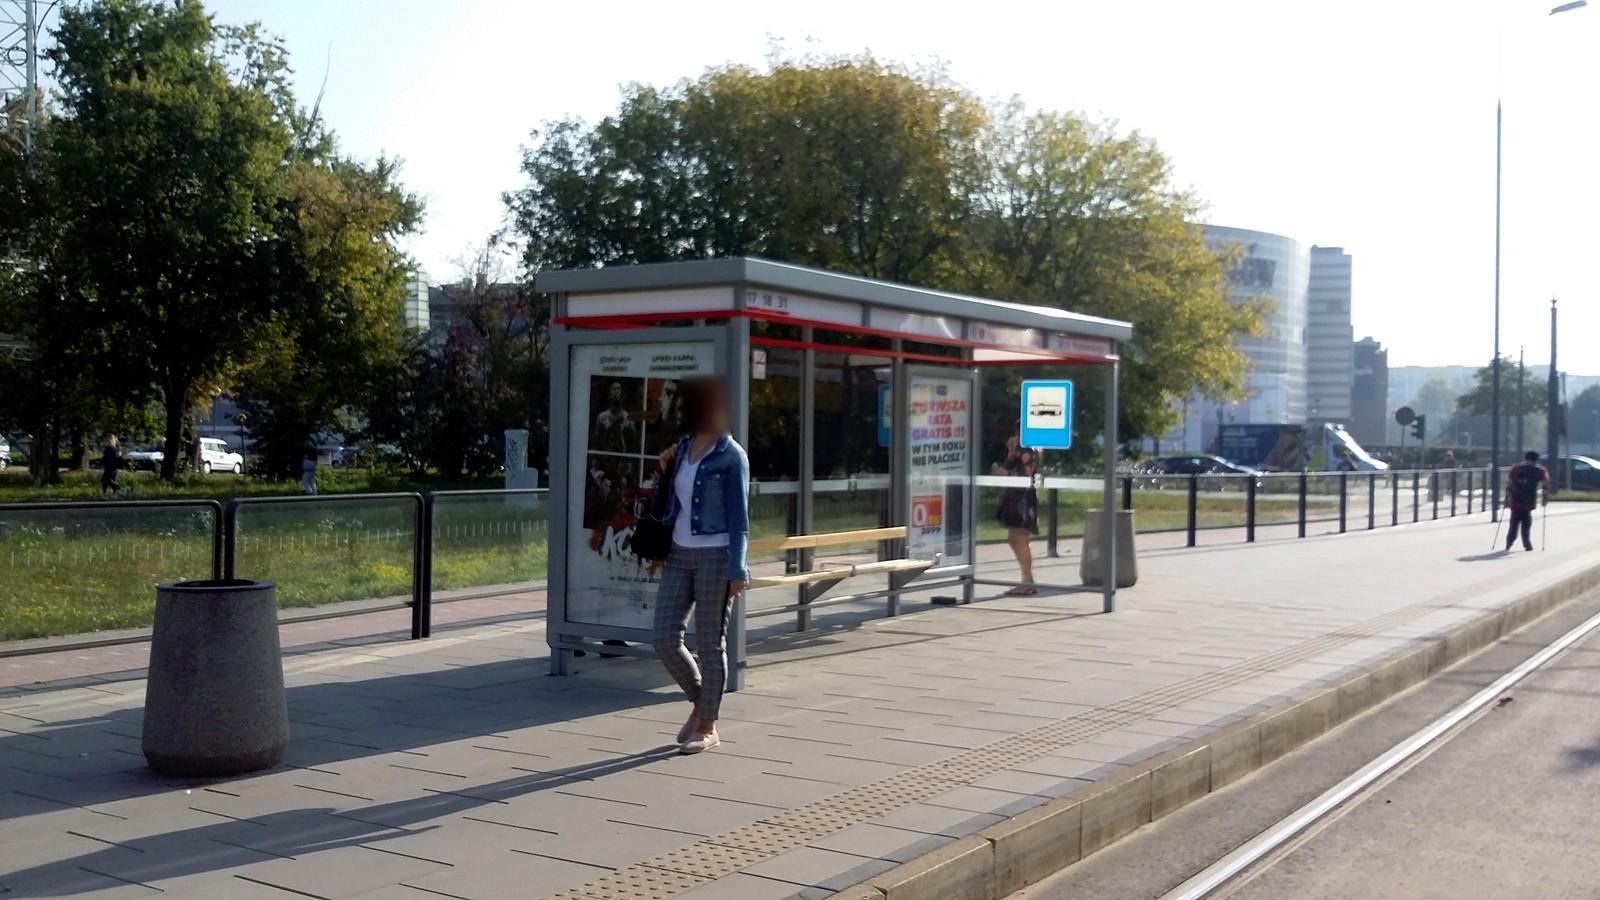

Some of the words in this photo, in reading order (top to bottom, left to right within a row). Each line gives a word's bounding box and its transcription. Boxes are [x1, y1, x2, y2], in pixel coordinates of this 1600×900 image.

[911, 426, 952, 440] GRATIS
[912, 445, 921, 454] W
[923, 443, 940, 452] TYM
[942, 441, 965, 451] ROKU
[912, 456, 926, 466] NIE
[928, 453, 960, 464] PŁACISZ
